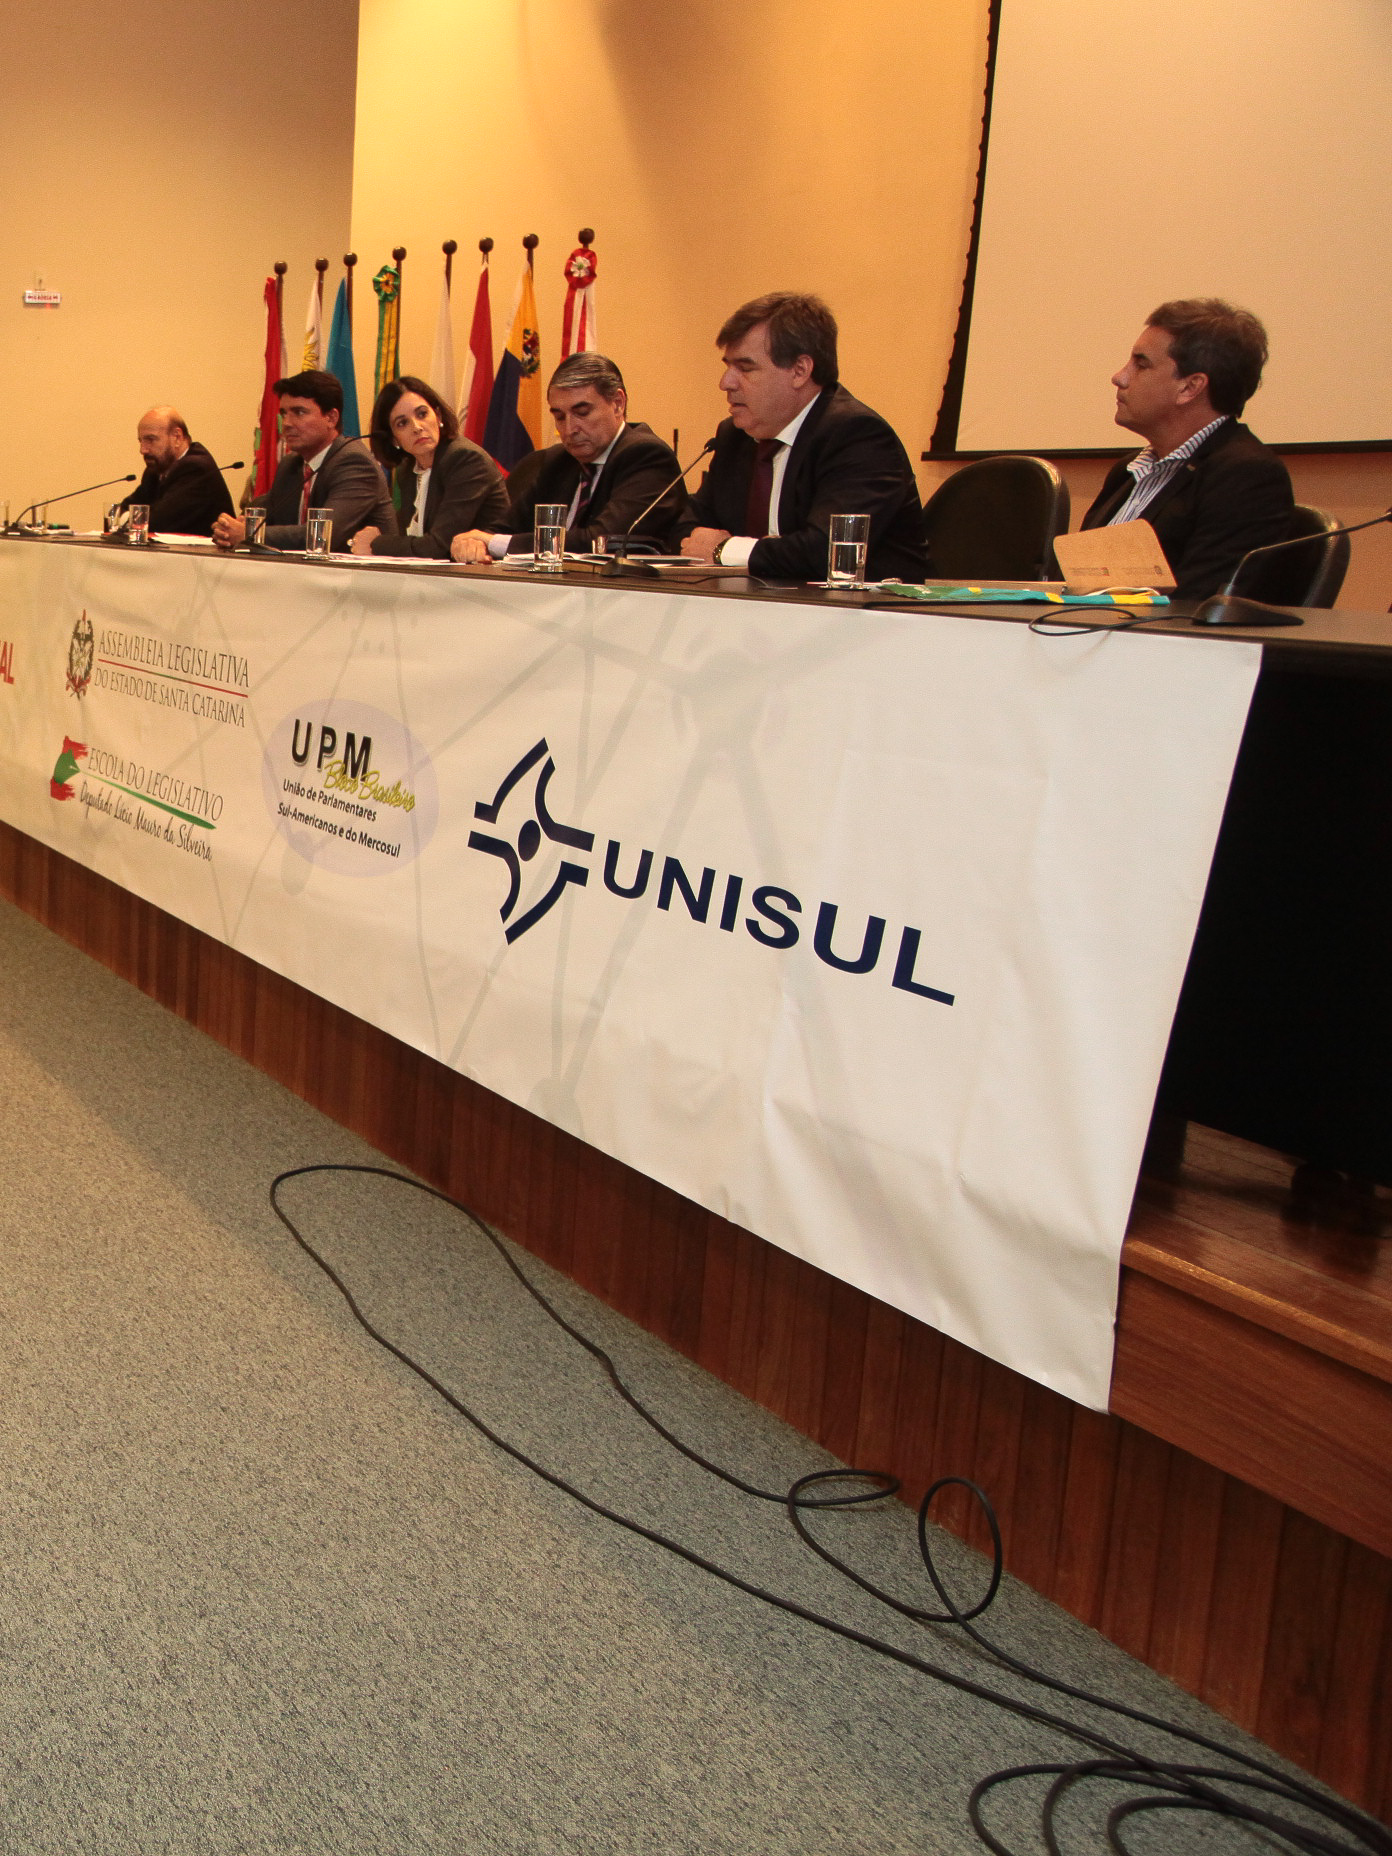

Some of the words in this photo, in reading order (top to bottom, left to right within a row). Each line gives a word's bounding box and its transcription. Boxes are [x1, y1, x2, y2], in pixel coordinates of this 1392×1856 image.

[98, 630, 164, 668] ASSEMBLEIA
[168, 643, 249, 688] LEGISLATIVA
[95, 668, 109, 688] DO
[110, 671, 144, 697] ESTADO
[145, 681, 158, 702] DE
[159, 685, 189, 712] SANTA
[192, 693, 245, 727] CATARINA
[292, 718, 372, 782] UPM
[88, 748, 124, 782] ESCOLA
[126, 762, 144, 789] DO
[146, 770, 224, 821] LEGISLATIVO
[283, 779, 305, 797] União
[306, 787, 317, 800] de
[317, 790, 377, 822] Parlamentares
[358, 770, 415, 813] Brasileiro
[80, 780, 112, 819] Deputado
[133, 806, 162, 838] Mauro
[163, 816, 174, 844] da
[177, 823, 213, 861] Silveira
[277, 802, 338, 835] Sul-Americanos
[338, 826, 345, 838] e
[345, 827, 357, 842] do
[359, 831, 401, 858] Mercosul
[603, 839, 956, 1007] UNISUL
